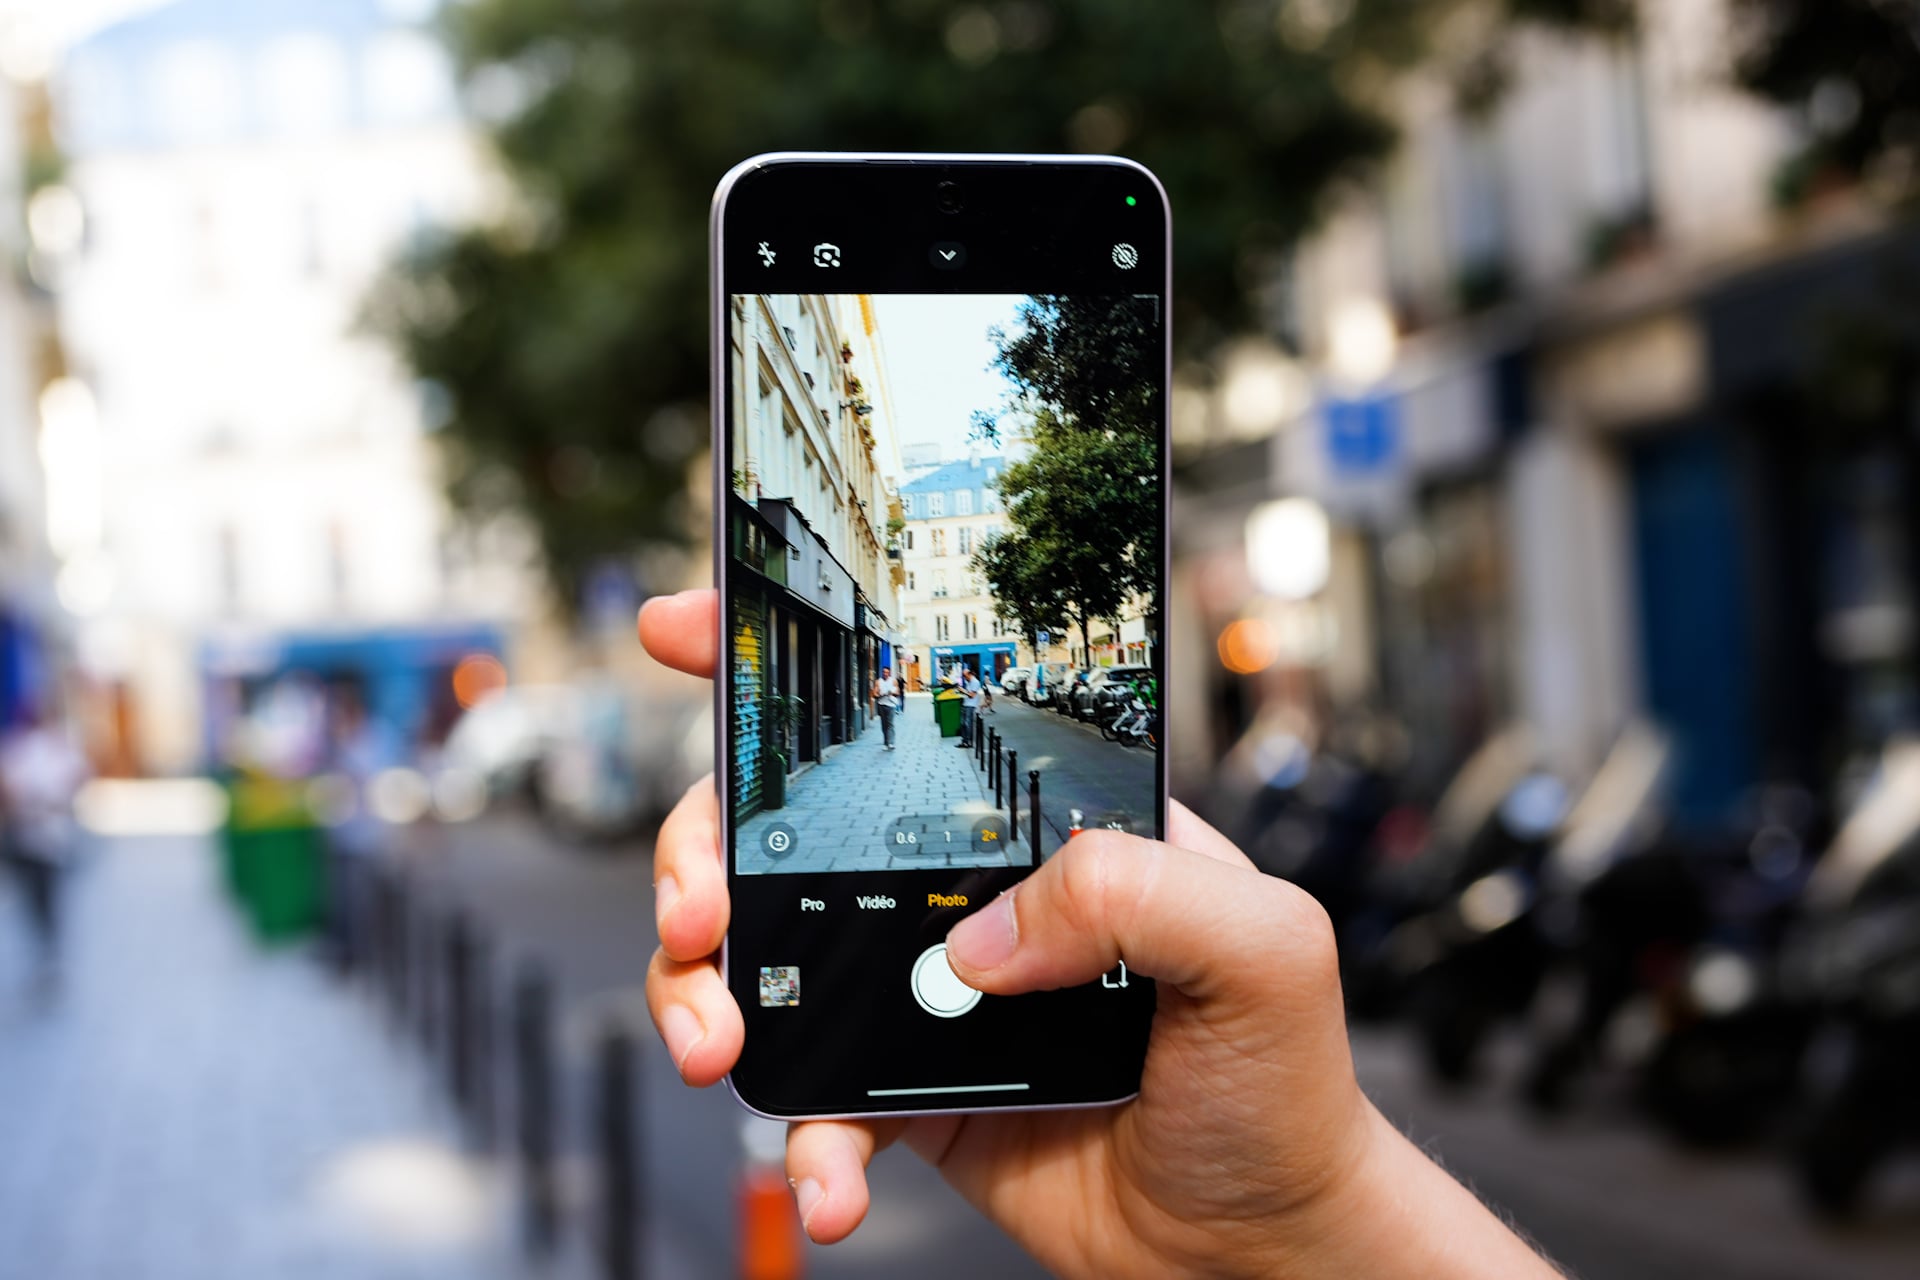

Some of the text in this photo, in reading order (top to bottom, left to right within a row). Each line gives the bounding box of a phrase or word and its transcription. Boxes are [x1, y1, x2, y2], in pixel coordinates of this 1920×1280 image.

[896, 831, 917, 844] 0.6
[944, 831, 951, 842] 1
[801, 893, 969, 911] Pro Vidéo Photo
